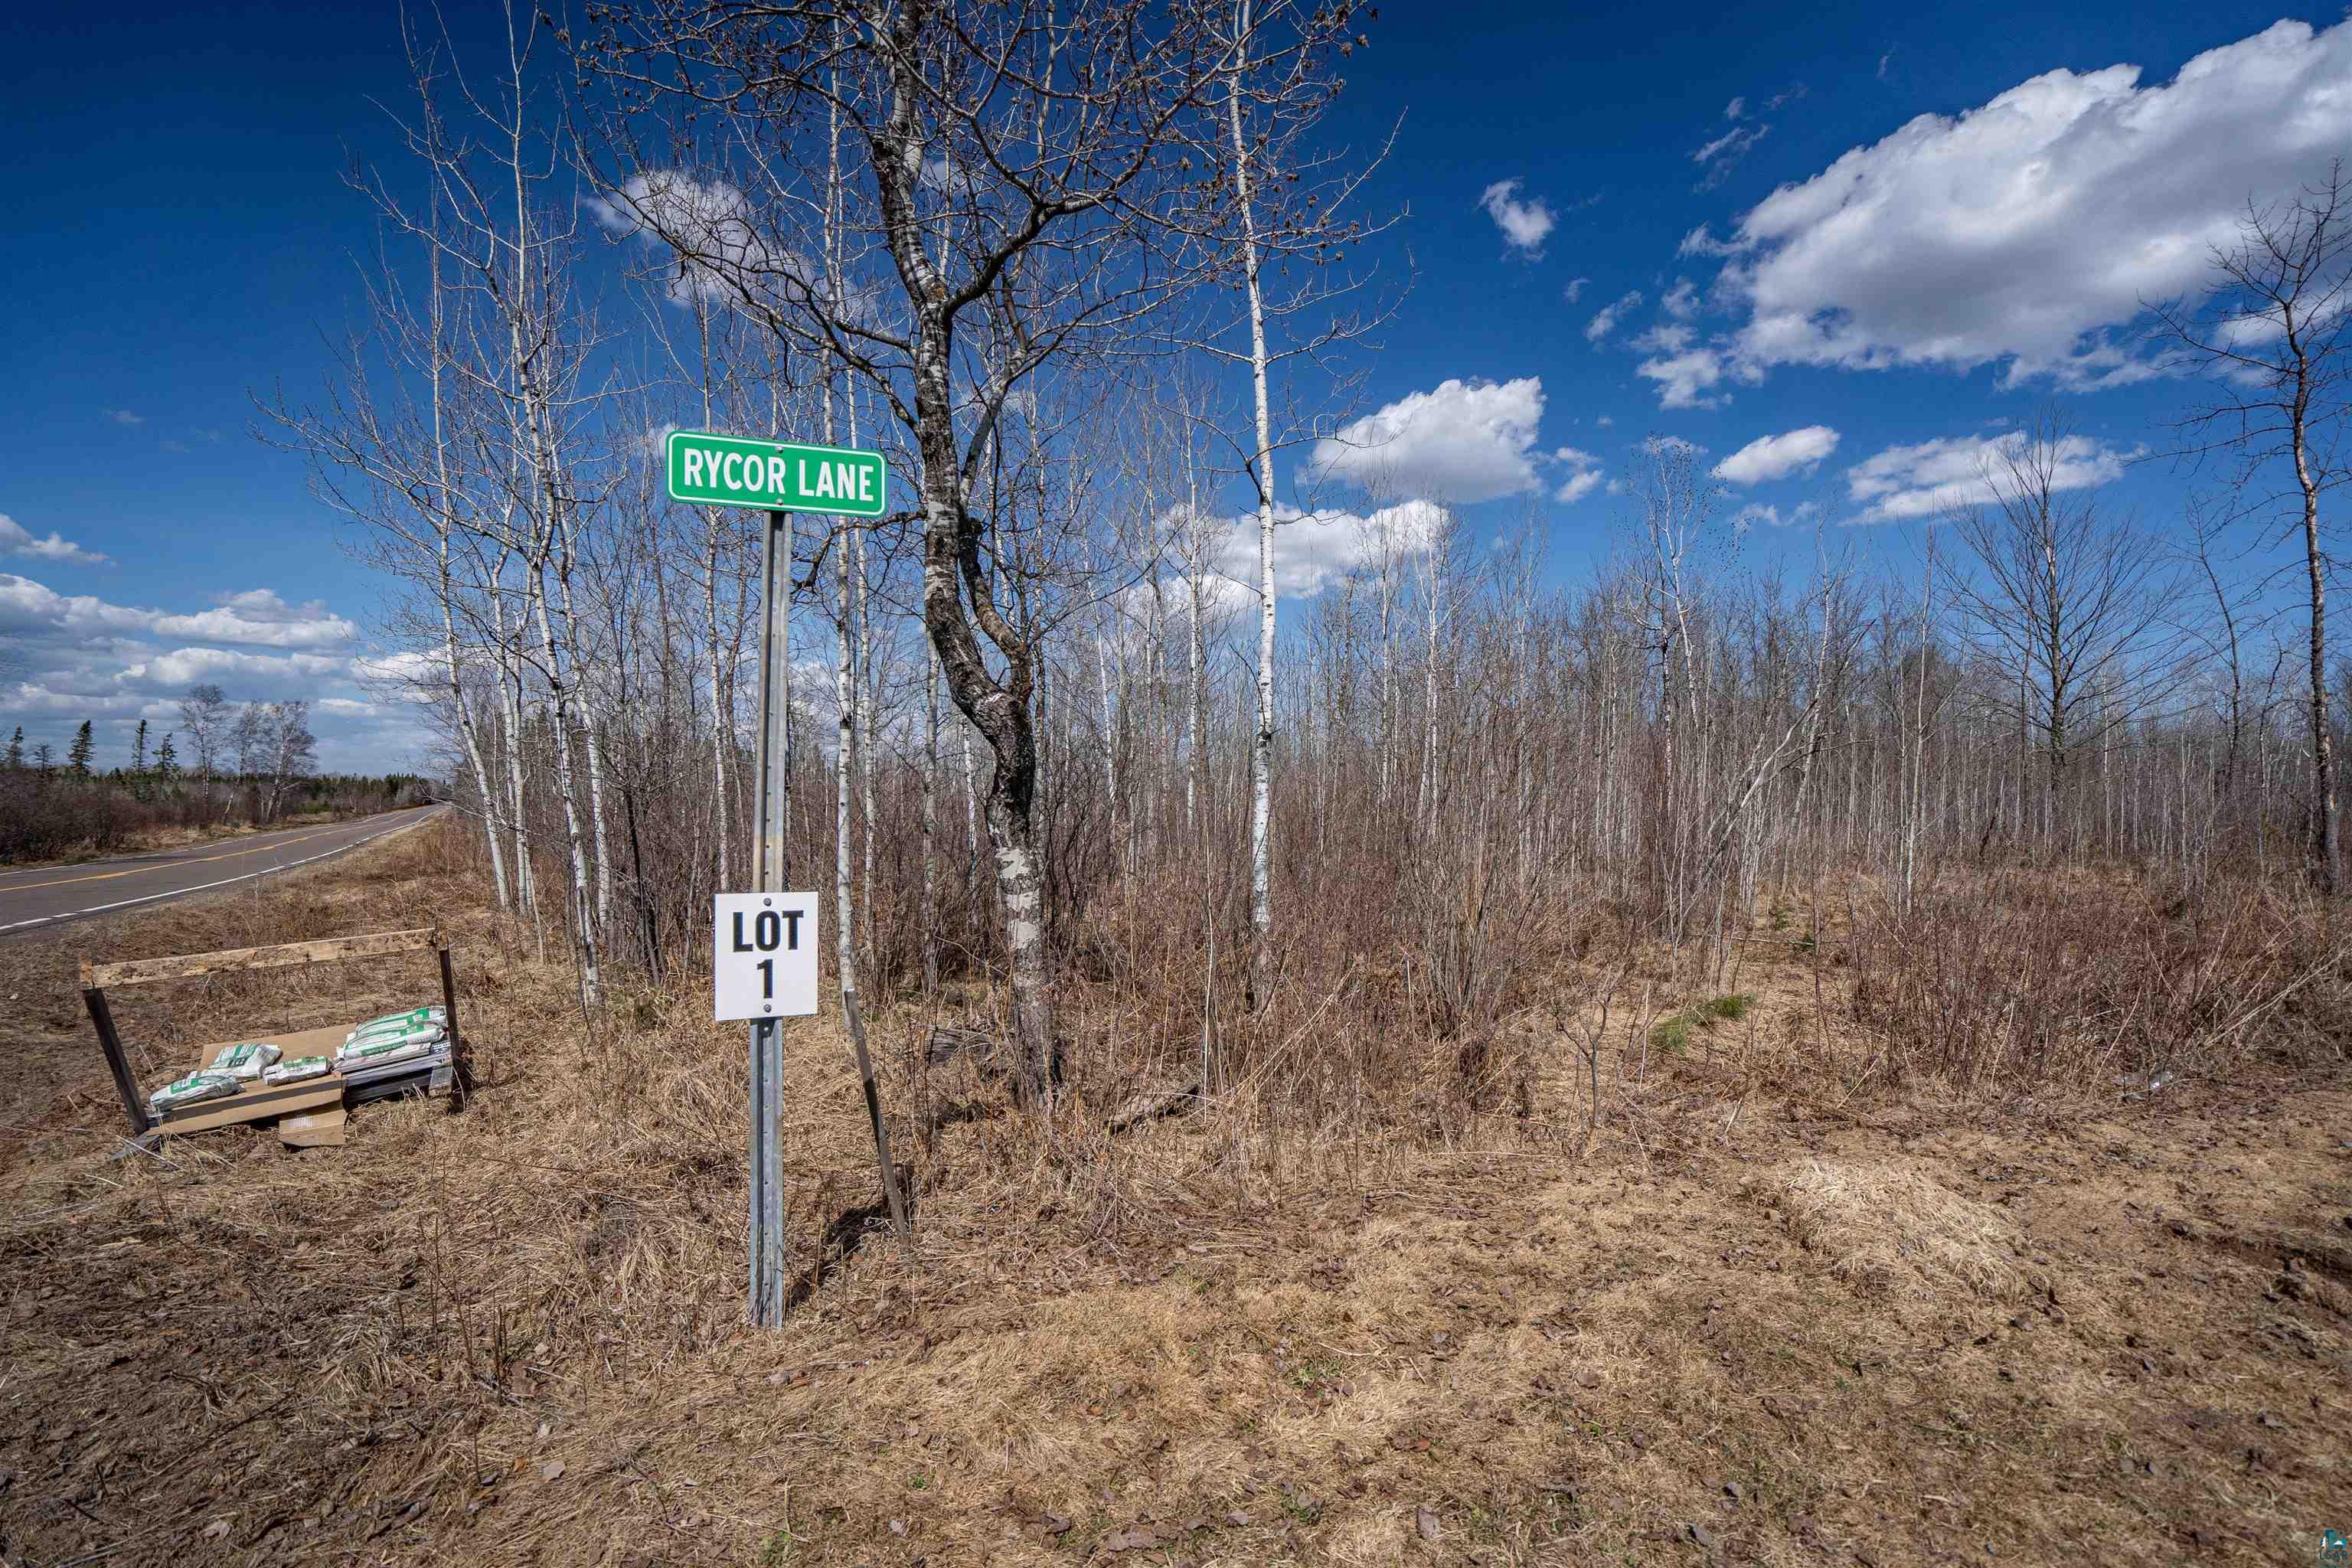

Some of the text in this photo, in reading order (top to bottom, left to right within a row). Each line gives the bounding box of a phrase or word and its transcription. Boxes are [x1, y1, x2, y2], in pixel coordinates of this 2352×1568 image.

[684, 448, 874, 502] RYCOR LANE
[733, 910, 805, 952] LOT
[756, 959, 773, 999] 1
